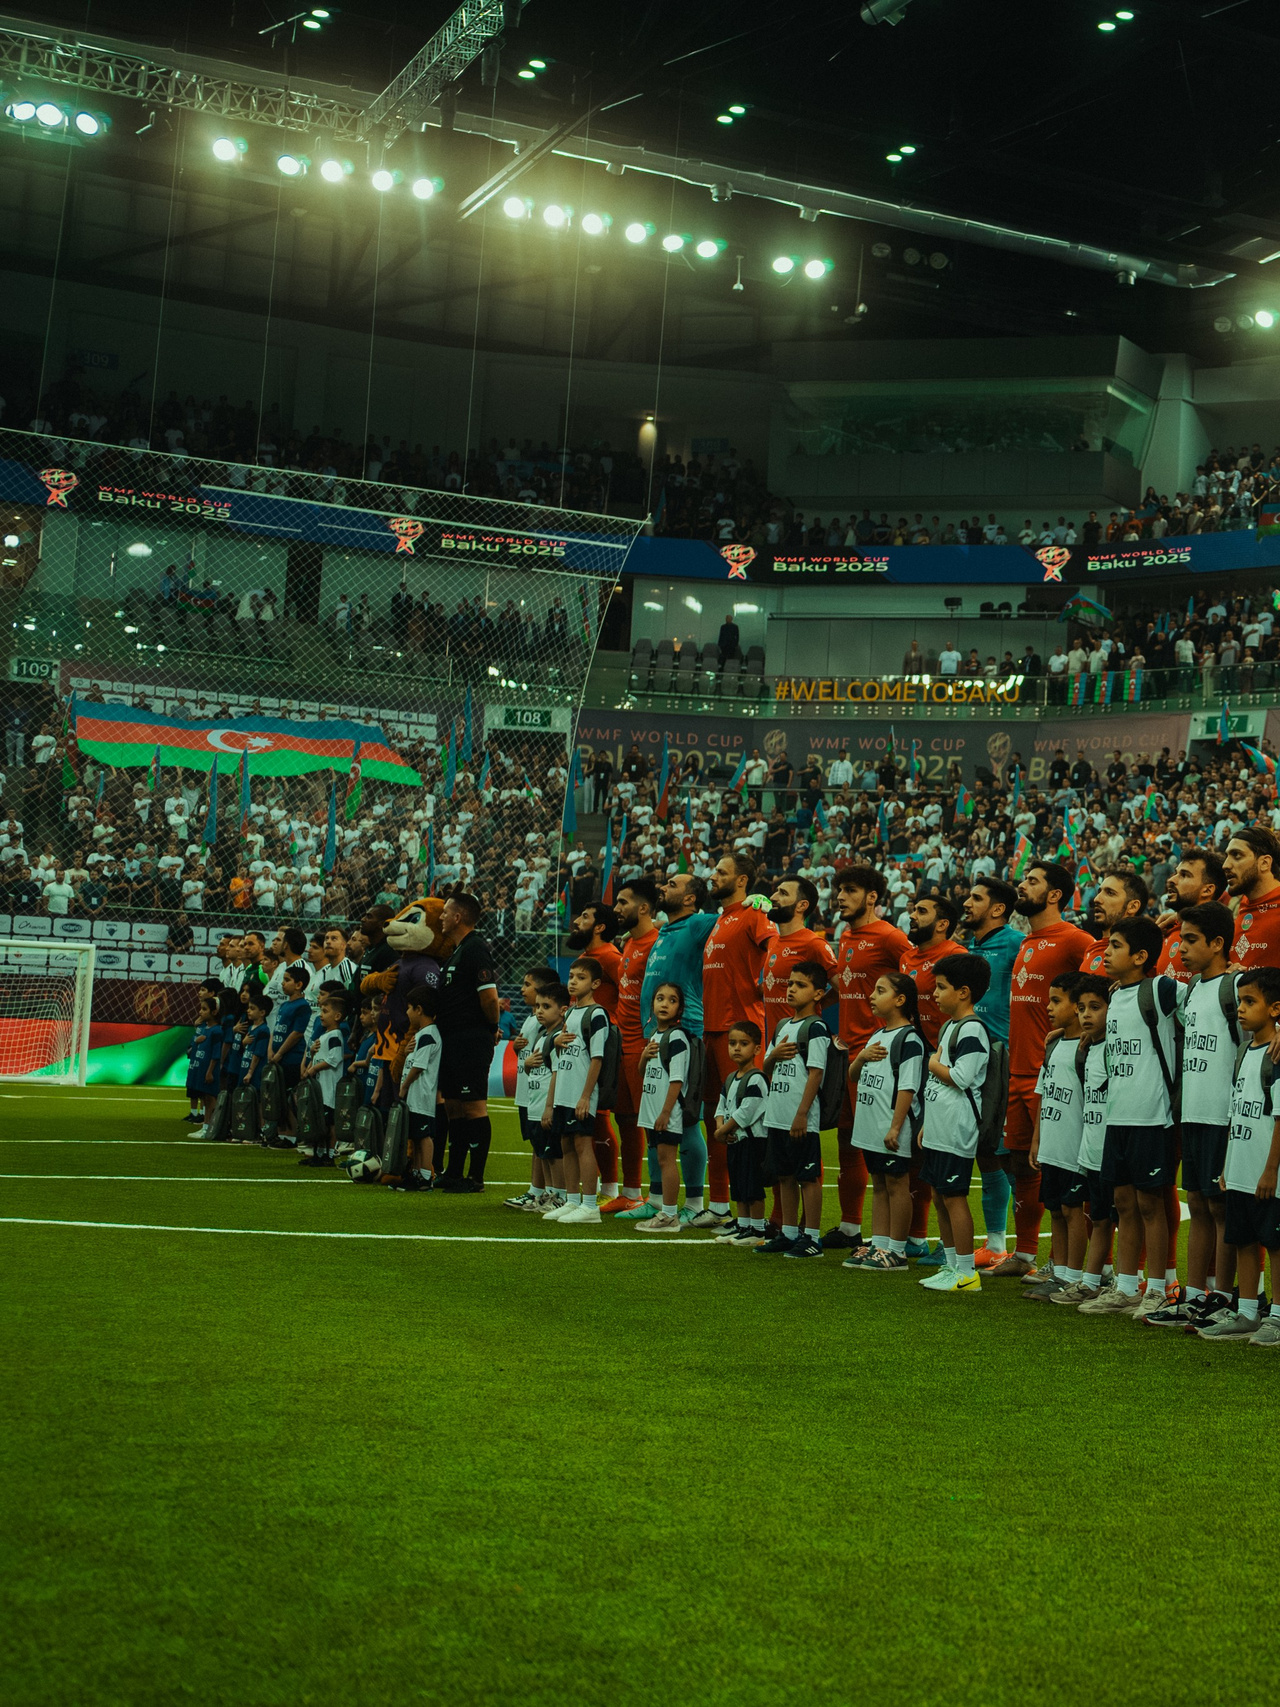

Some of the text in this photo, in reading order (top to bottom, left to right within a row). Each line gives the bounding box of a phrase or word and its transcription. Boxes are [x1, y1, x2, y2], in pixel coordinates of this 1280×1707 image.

[99, 485, 232, 508] WMF WORLD CUP
[98, 491, 231, 518] Baku 2025
[441, 538, 566, 557] Baku 2025
[482, 536, 534, 545] WORLD
[1121, 550, 1163, 558] WORLD
[1168, 546, 1192, 554] CUP
[773, 562, 889, 572] Baku 2025
[1086, 552, 1191, 572] Baku 2025
[20, 661, 50, 677] 109
[775, 681, 1020, 703] #WELCOMETOBAKU
[515, 710, 542, 724] 108
[1216, 718, 1239, 731] 17
[578, 727, 744, 748] WMF WORLD CUP
[809, 737, 851, 750] WMF
[930, 738, 966, 751] CUP
[1033, 738, 1070, 752] WMF
[1076, 735, 1133, 750] WORLD
[1251, 942, 1268, 951] group
[1029, 973, 1044, 981] group
[1176, 971, 1192, 979] group
